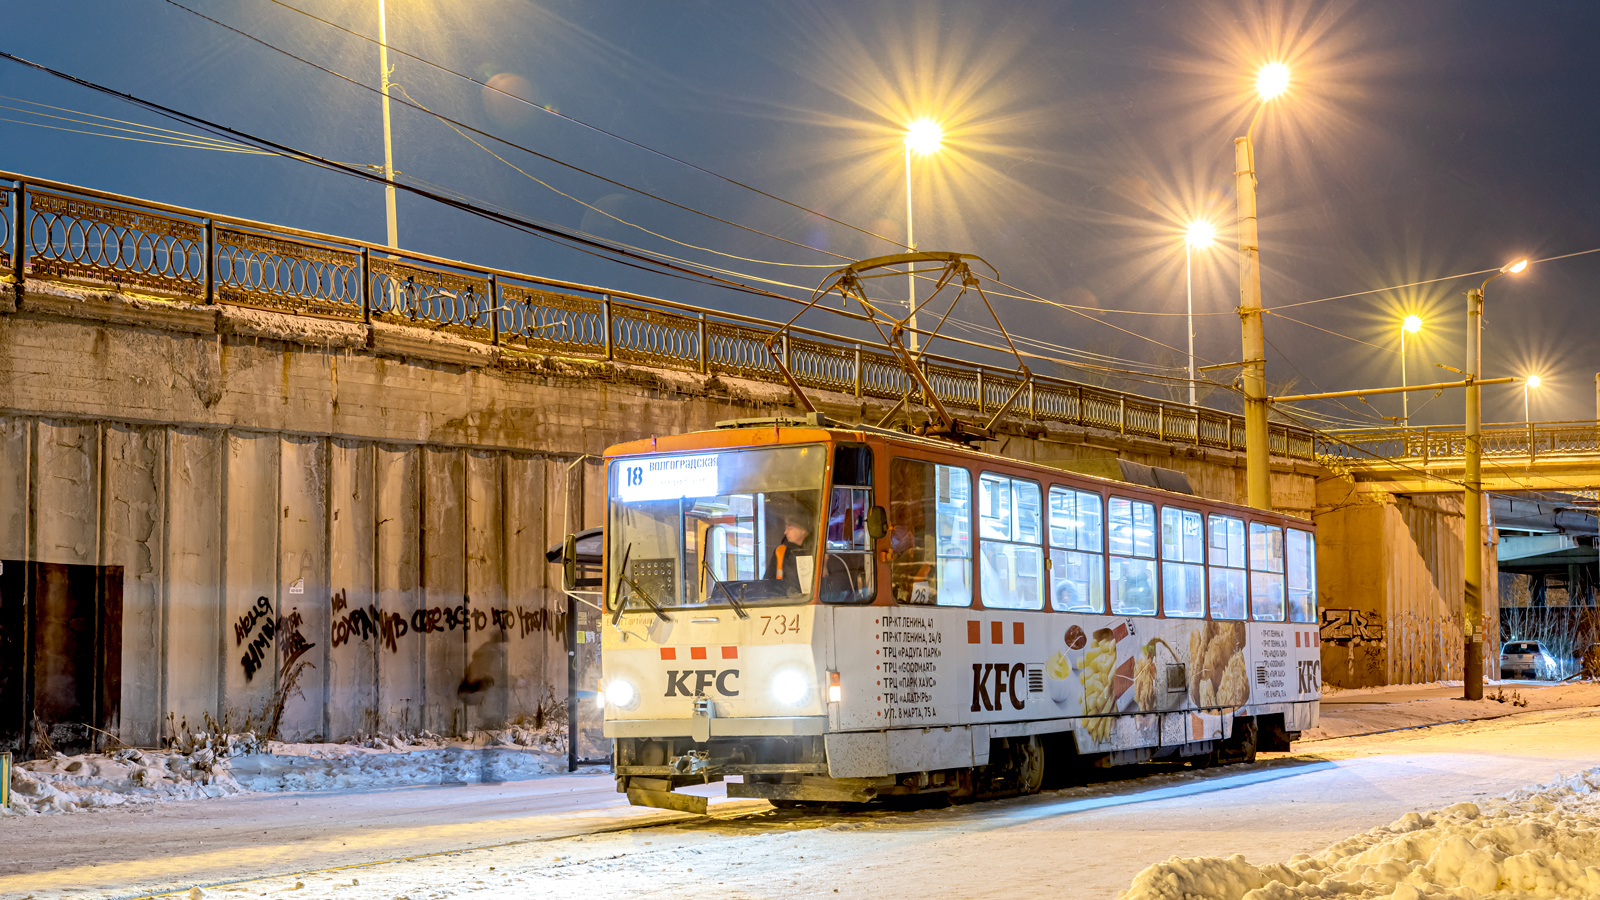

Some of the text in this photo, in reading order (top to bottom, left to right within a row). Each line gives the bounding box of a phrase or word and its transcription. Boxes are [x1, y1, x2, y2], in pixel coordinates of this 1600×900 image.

[626, 466, 643, 487] 18
[915, 588, 926, 602] 26
[760, 614, 801, 635] 734
[882, 616, 901, 628] ПР-КТ
[902, 616, 927, 631] ЛЕНИНА,
[882, 631, 901, 643] ПР-КТ
[903, 632, 927, 645] ЛЕНИНА,
[883, 647, 897, 659] ТРЦ
[883, 662, 898, 675] ТРЦ
[665, 669, 740, 697] KFC
[883, 677, 898, 690] ТРЦ
[1297, 660, 1321, 694] KFC
[971, 662, 1026, 713] KFC
[884, 693, 899, 705] ТРЦ
